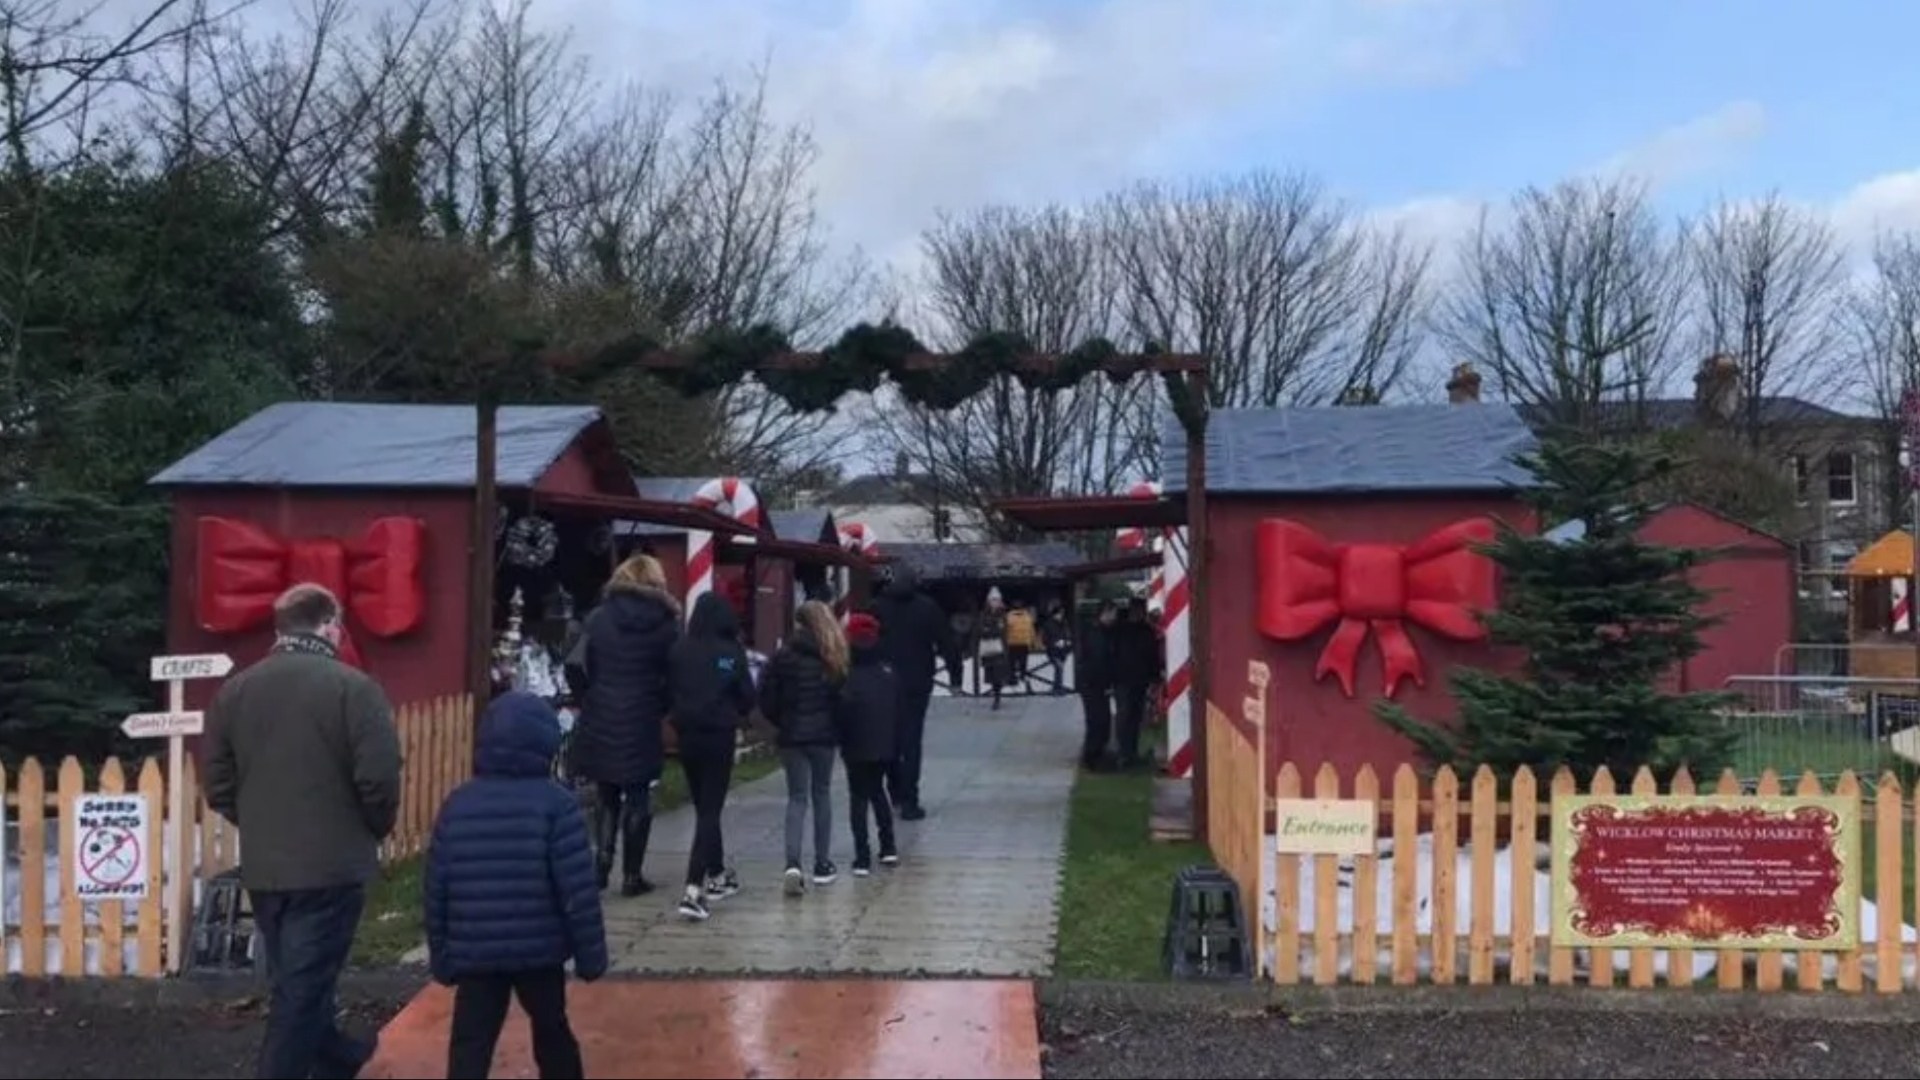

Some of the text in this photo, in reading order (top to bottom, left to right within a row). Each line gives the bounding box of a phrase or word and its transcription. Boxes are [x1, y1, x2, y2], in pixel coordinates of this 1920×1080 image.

[161, 659, 212, 676] CRAFTS
[1282, 816, 1368, 836] Entrance
[1596, 826, 1814, 840] WICKLOW CHRISTMAS MARKET
